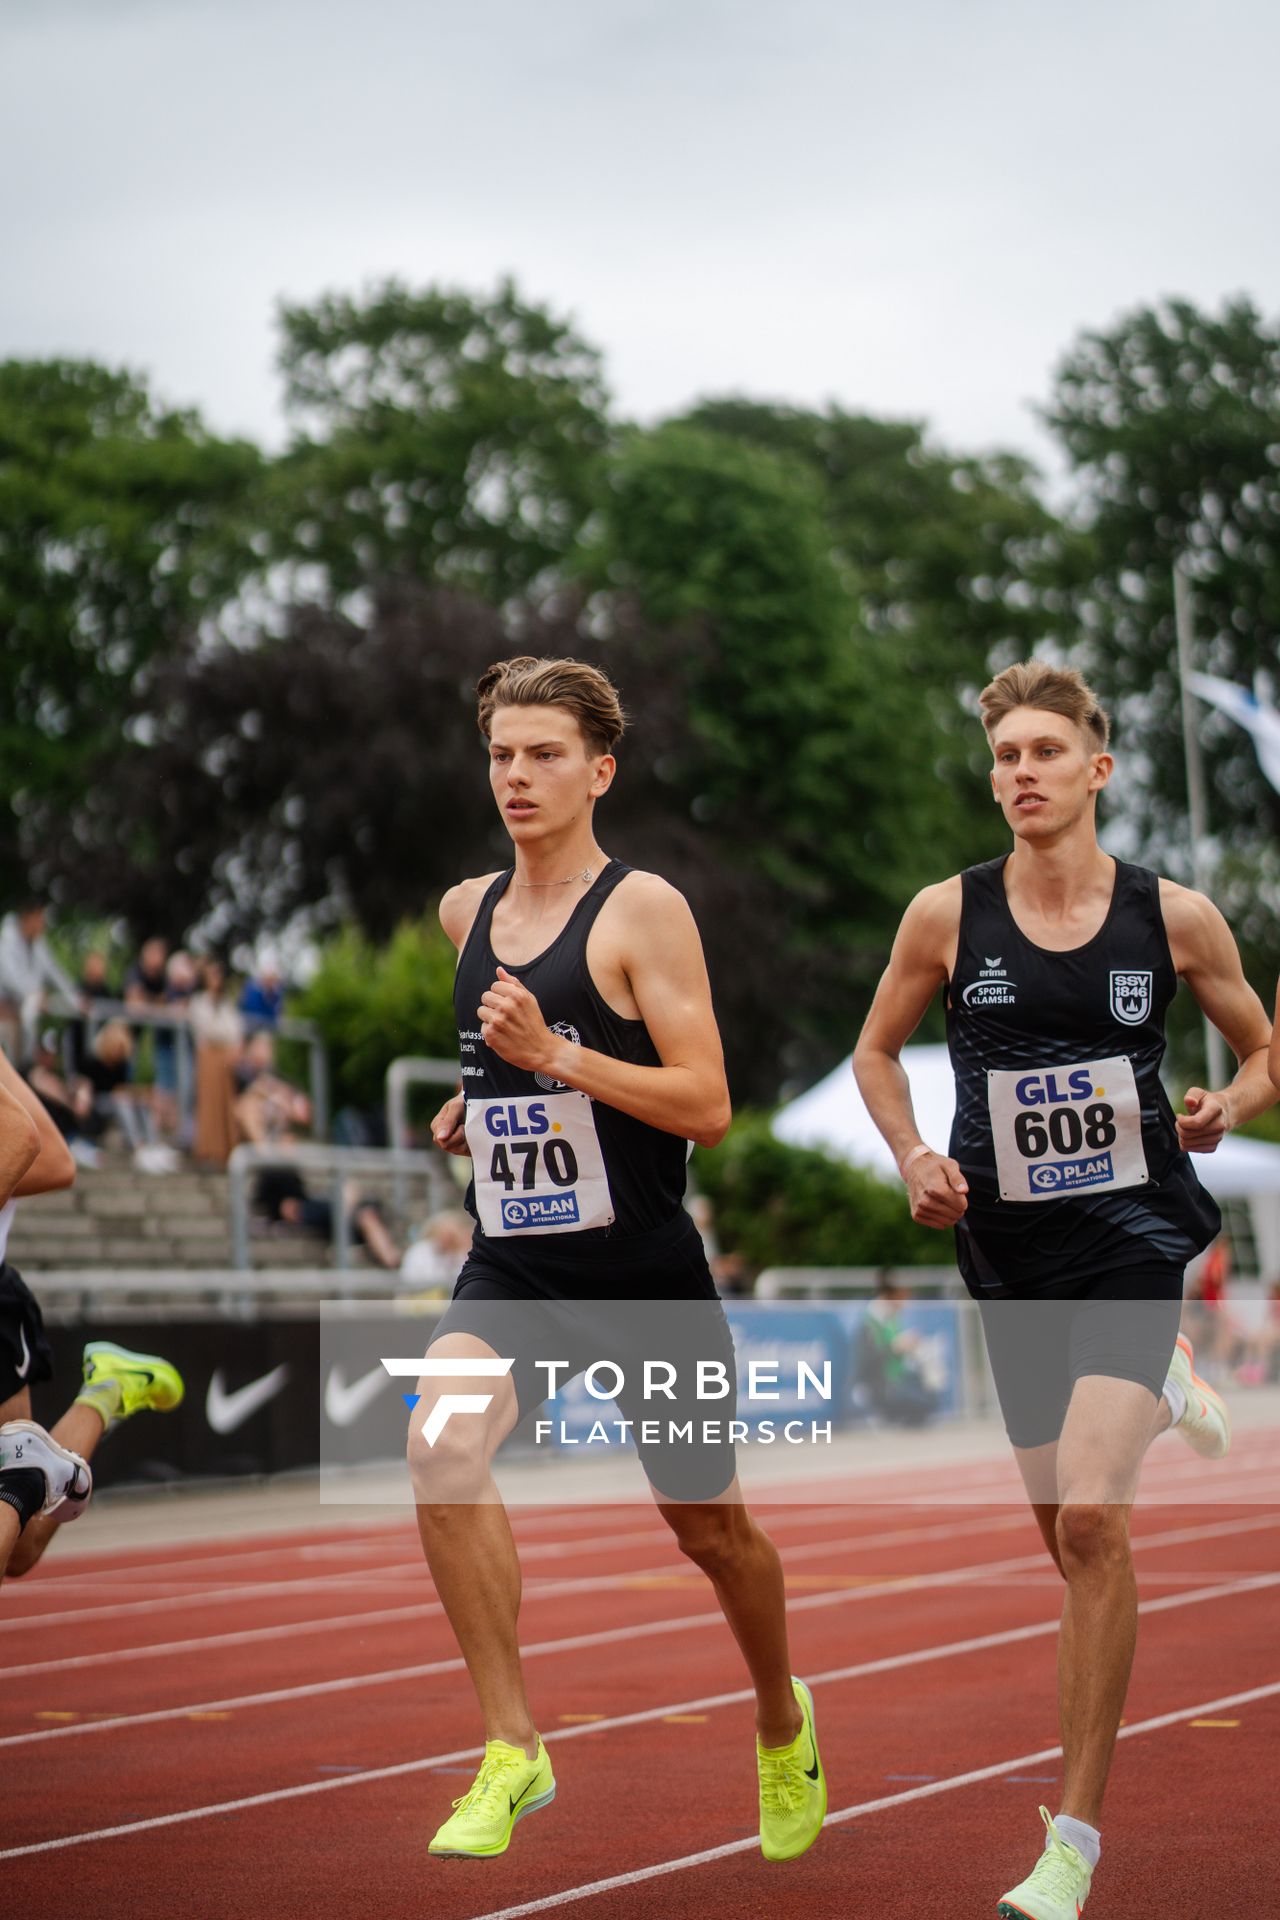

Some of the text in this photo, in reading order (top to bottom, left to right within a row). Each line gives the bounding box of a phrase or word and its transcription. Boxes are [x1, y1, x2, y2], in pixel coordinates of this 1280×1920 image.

[979, 968, 1007, 977] erima
[1114, 975, 1149, 986] SSV
[978, 986, 1008, 996] SPORT
[1114, 986, 1148, 998] 1846
[971, 995, 1016, 1005] KLAMSER
[1014, 1103, 1116, 1158] 608
[490, 1138, 579, 1191] 470
[1063, 1158, 1109, 1179] PLAN
[1065, 1172, 1110, 1186] INTERNATIONAL
[528, 1198, 575, 1216] PLAN
[532, 1214, 576, 1223] INTERNATIONAL
